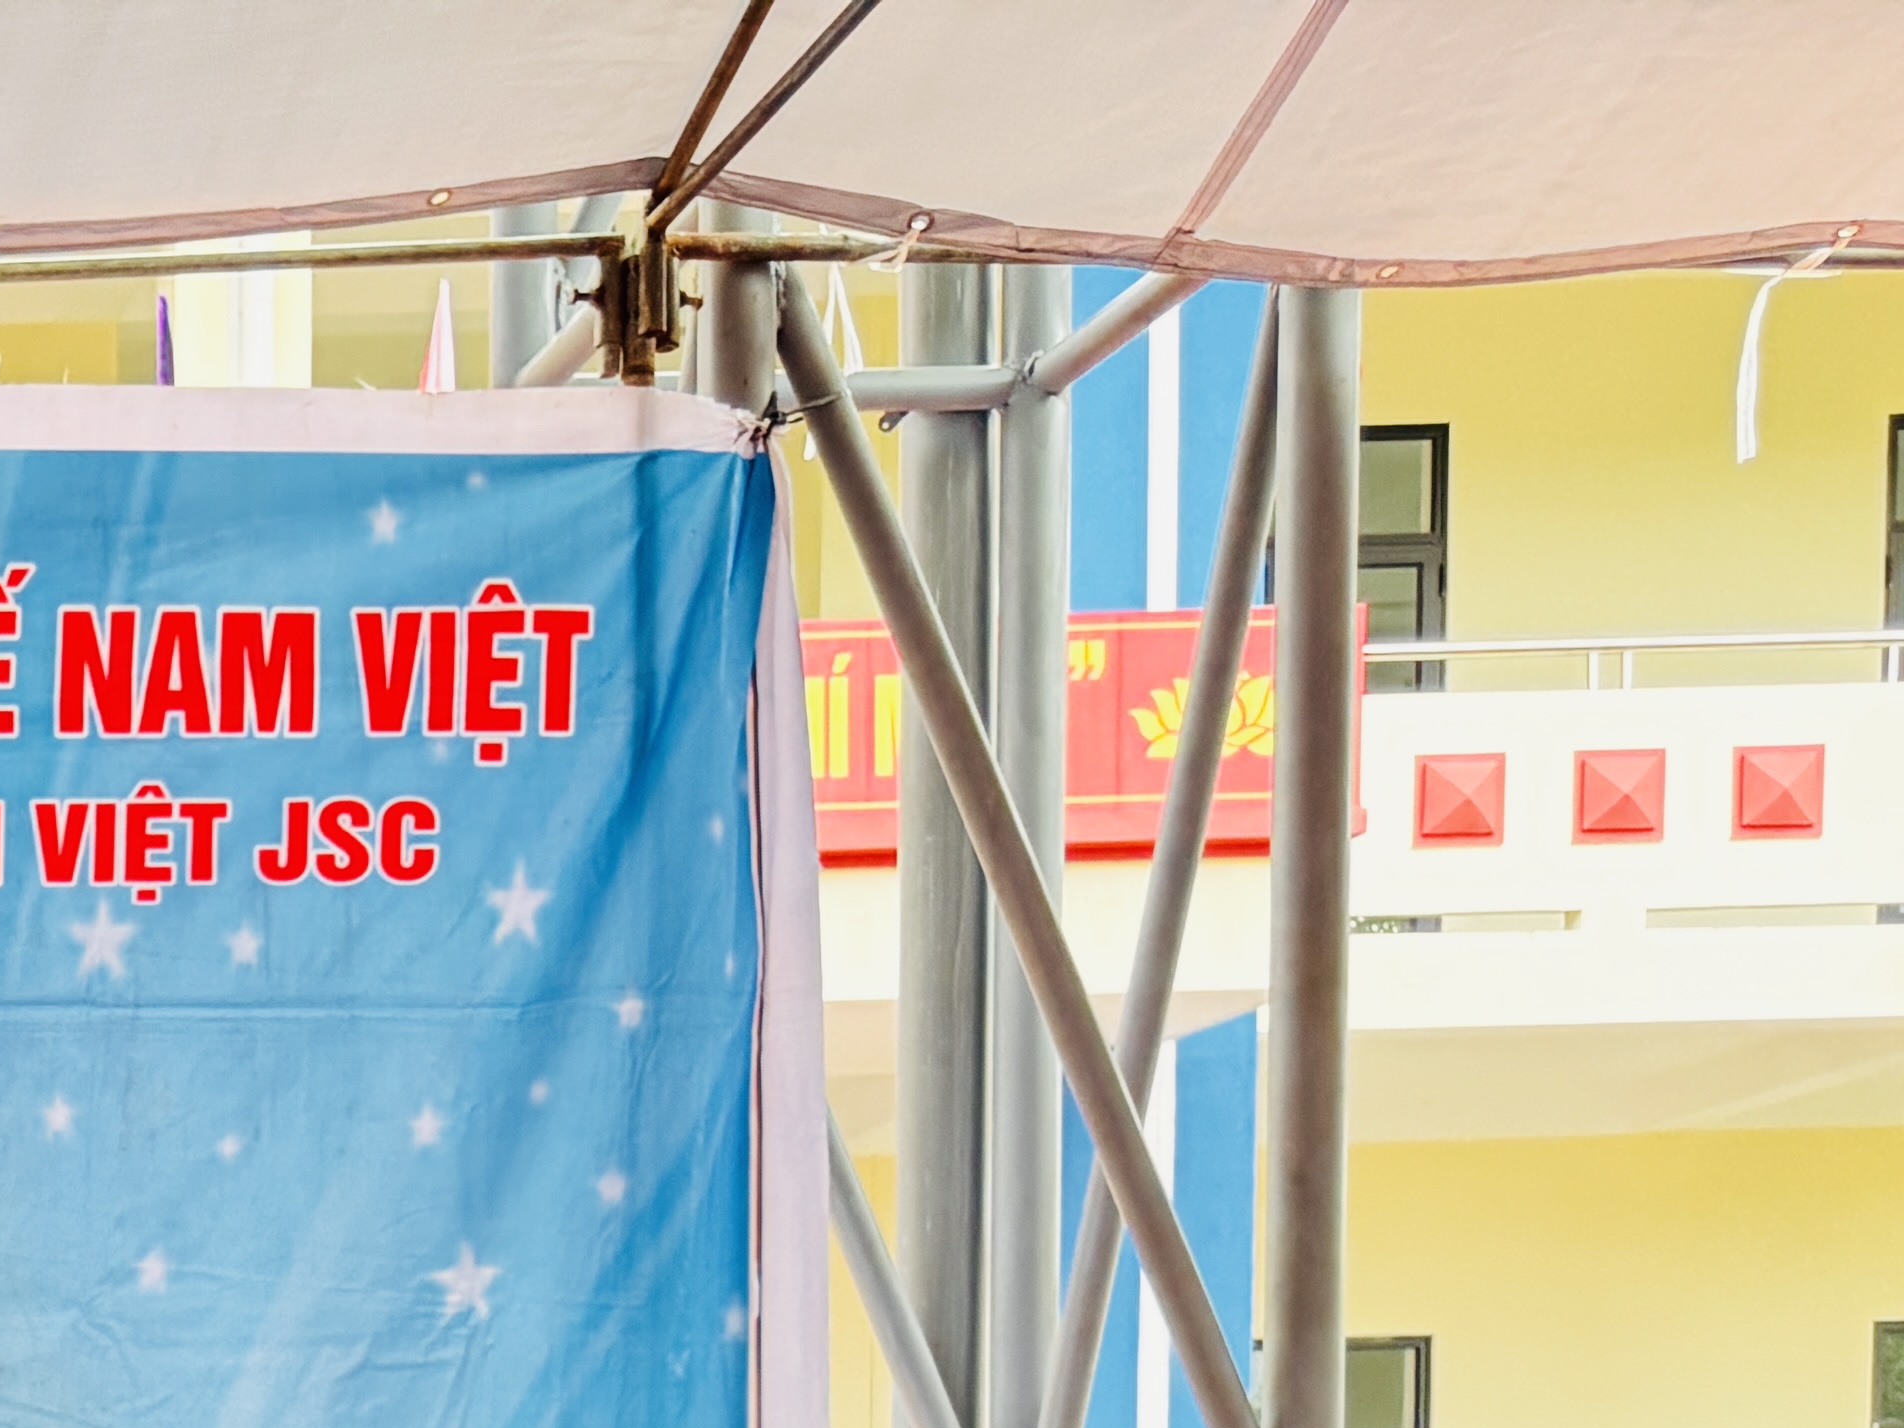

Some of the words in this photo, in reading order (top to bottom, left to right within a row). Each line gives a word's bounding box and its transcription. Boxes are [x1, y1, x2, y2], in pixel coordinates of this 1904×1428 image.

[60, 612, 314, 733] NAM
[357, 585, 588, 760] VIỆT
[36, 786, 226, 900] VIỆT
[260, 801, 434, 881] JSC
